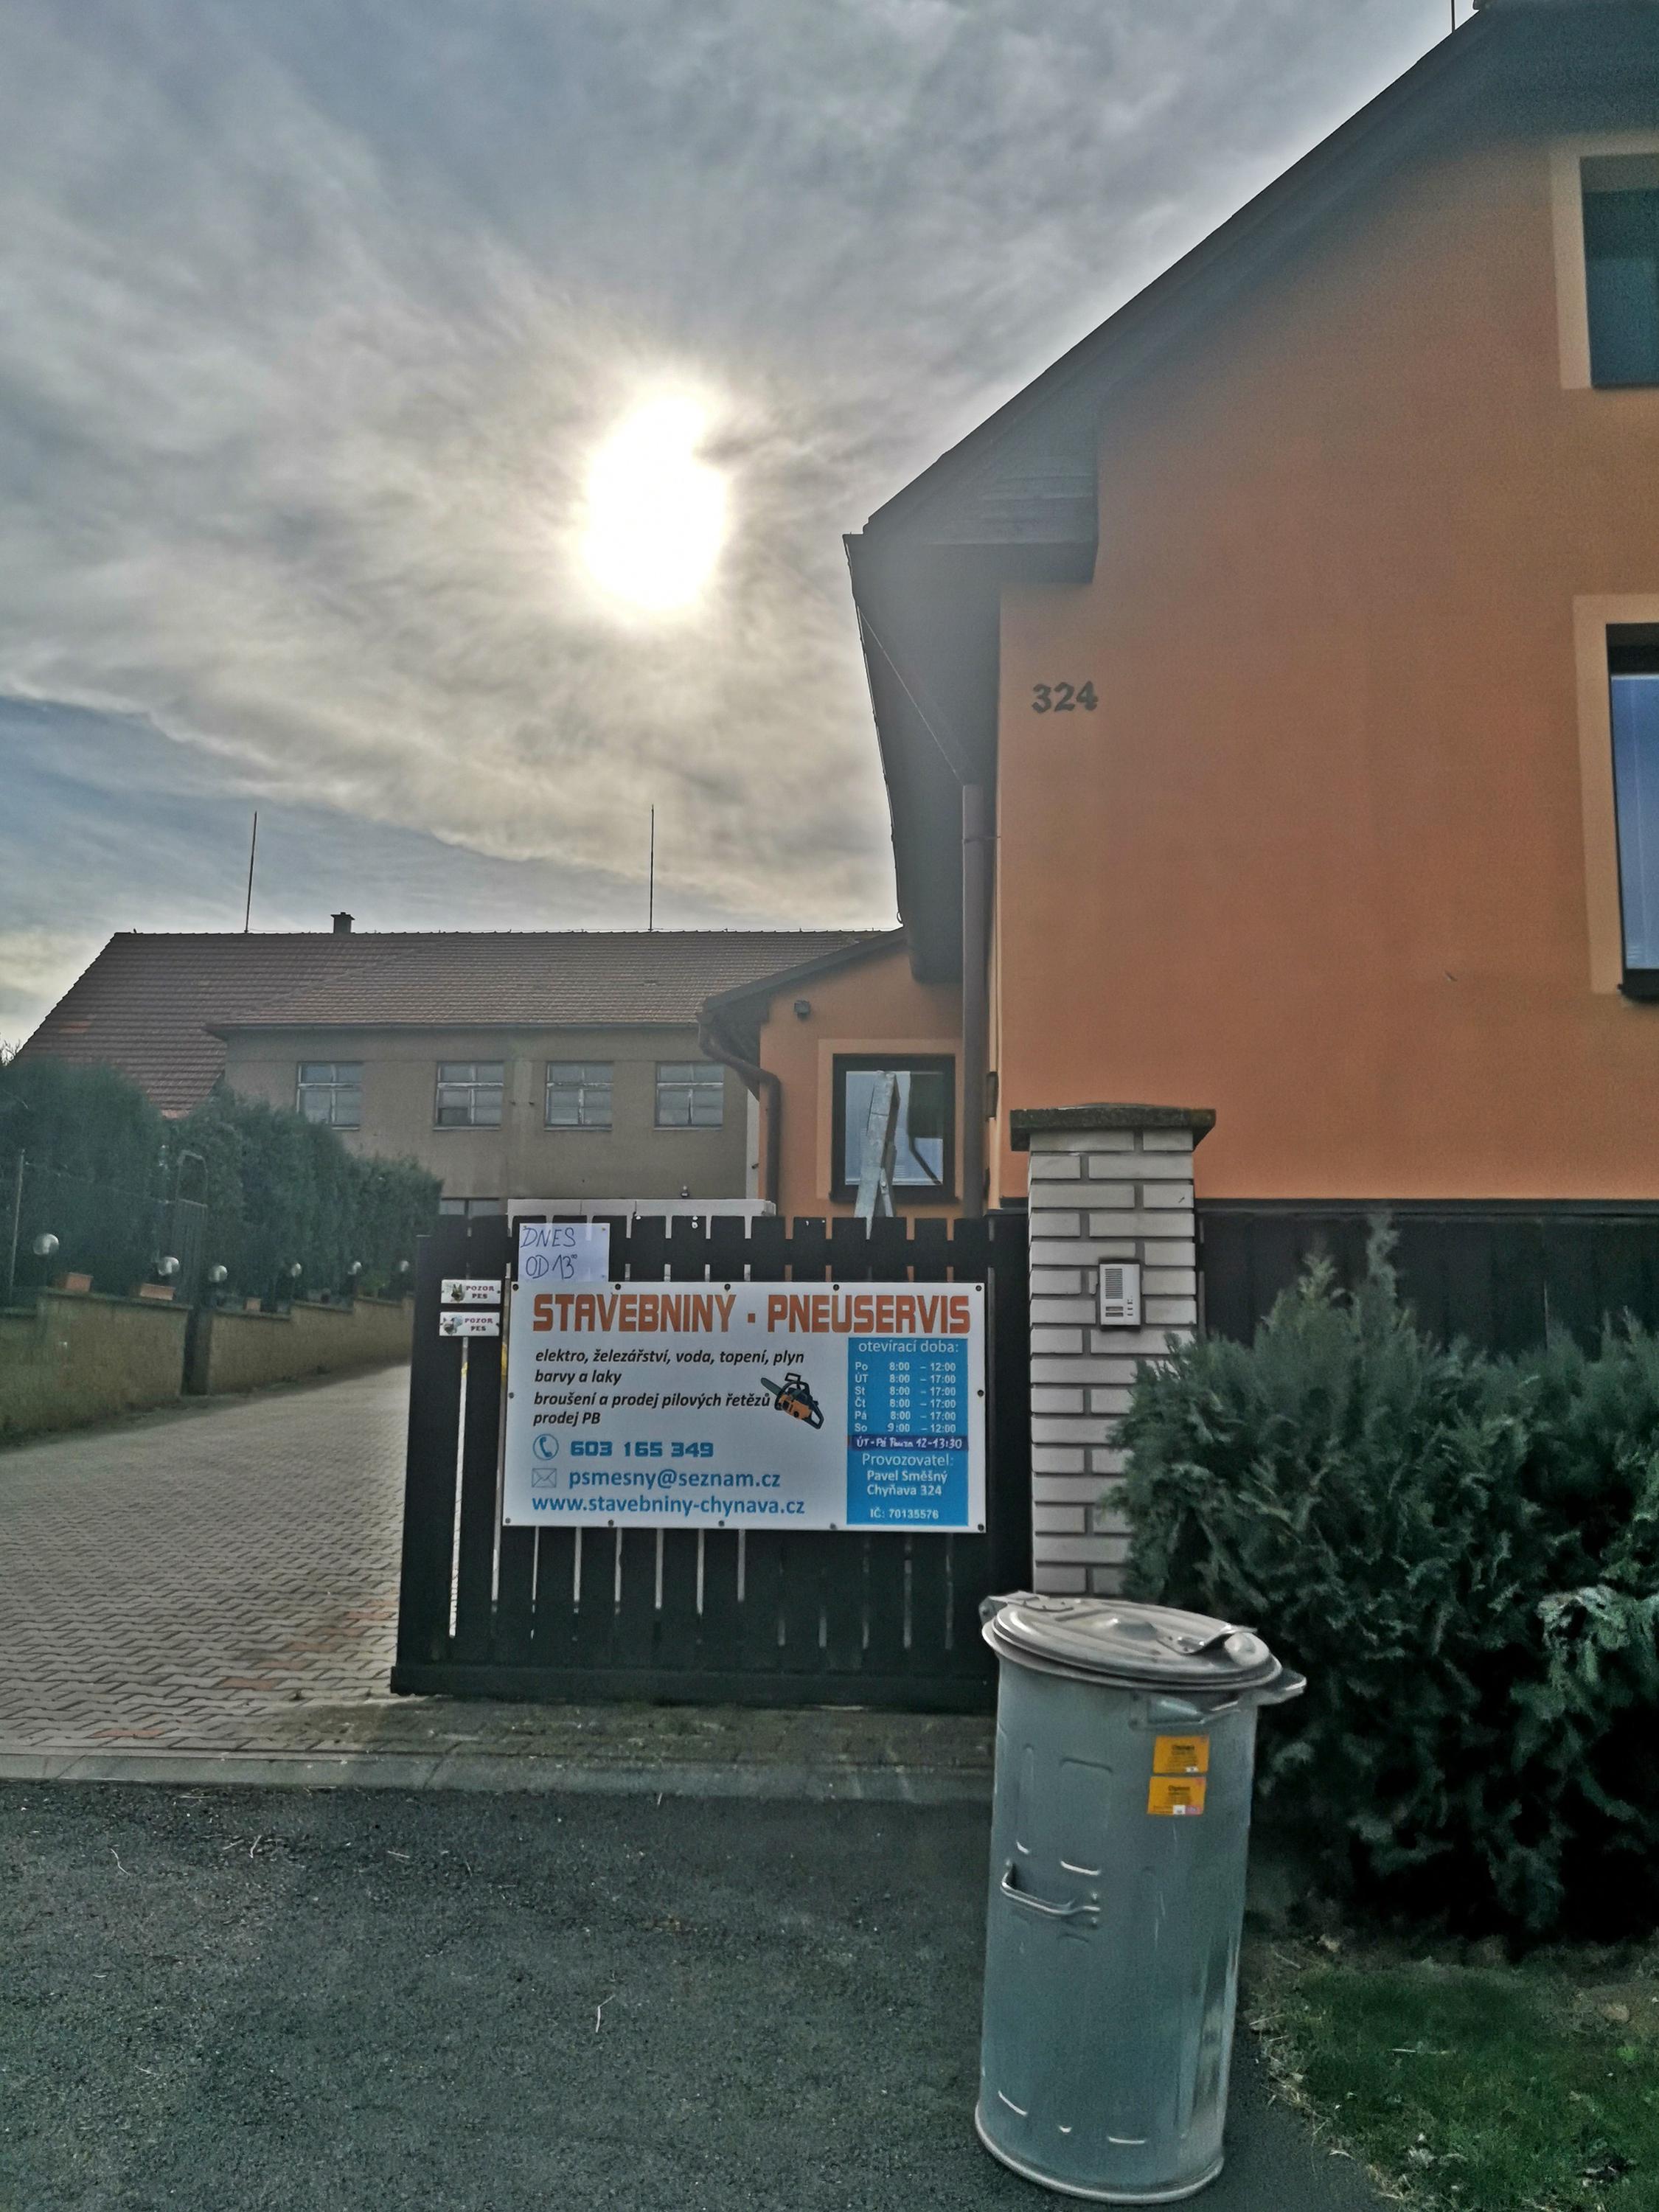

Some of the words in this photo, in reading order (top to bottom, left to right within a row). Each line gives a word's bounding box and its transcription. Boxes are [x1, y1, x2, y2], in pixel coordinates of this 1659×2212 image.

[1032, 681, 1099, 714] 324
[521, 1227, 576, 1248] DNES
[526, 1255, 549, 1279] OD
[532, 1293, 737, 1332] STAVEBNINY
[768, 1294, 970, 1334] PNEUSERVIS
[858, 1340, 917, 1352] otevírací
[921, 1340, 959, 1353] doba:
[535, 1349, 589, 1364] elektro,
[593, 1349, 672, 1364] železářství,
[676, 1349, 715, 1365] voda,
[720, 1350, 769, 1366] topení,
[773, 1351, 804, 1366] plyn
[855, 1363, 868, 1371] Po
[889, 1362, 910, 1371] 8:00
[930, 1363, 956, 1372] 12:00
[535, 1370, 575, 1385] barvy
[579, 1374, 587, 1382] a
[591, 1370, 622, 1385] laky
[855, 1372, 869, 1383] ÚT
[889, 1374, 910, 1384] 8:00
[930, 1374, 956, 1385] 17:00
[855, 1386, 866, 1395] St
[889, 1386, 910, 1396] 8:00
[930, 1387, 956, 1397] 17:00
[534, 1392, 596, 1405] broušení
[599, 1396, 608, 1405] a
[611, 1393, 659, 1409] prodej
[662, 1393, 722, 1409] pilových
[726, 1394, 770, 1408] řetězů
[855, 1397, 866, 1408] Čt
[889, 1397, 910, 1408] 8:00
[930, 1398, 956, 1409] 17:00
[533, 1411, 579, 1427] prodej
[582, 1412, 601, 1425] PB
[855, 1411, 867, 1420] Pá
[889, 1411, 911, 1421] 8:00
[930, 1411, 956, 1422] 17:00
[855, 1423, 868, 1432] So
[887, 1423, 910, 1433] 9:00
[930, 1424, 956, 1433] 12:00
[570, 1441, 613, 1456] 603
[624, 1441, 664, 1458] 165
[671, 1441, 714, 1458] 349
[862, 1453, 954, 1467] Provozovatel:
[568, 1469, 781, 1489] psmesny@seznam.cz
[867, 1470, 898, 1481] Pavel
[902, 1470, 948, 1484] Směšný
[867, 1484, 917, 1498] Chyňava
[921, 1485, 942, 1496] 324
[532, 1495, 805, 1517] www.stavebniny-chynava.cz
[870, 1506, 884, 1519] IČ:
[889, 1509, 939, 1520] 70135576
